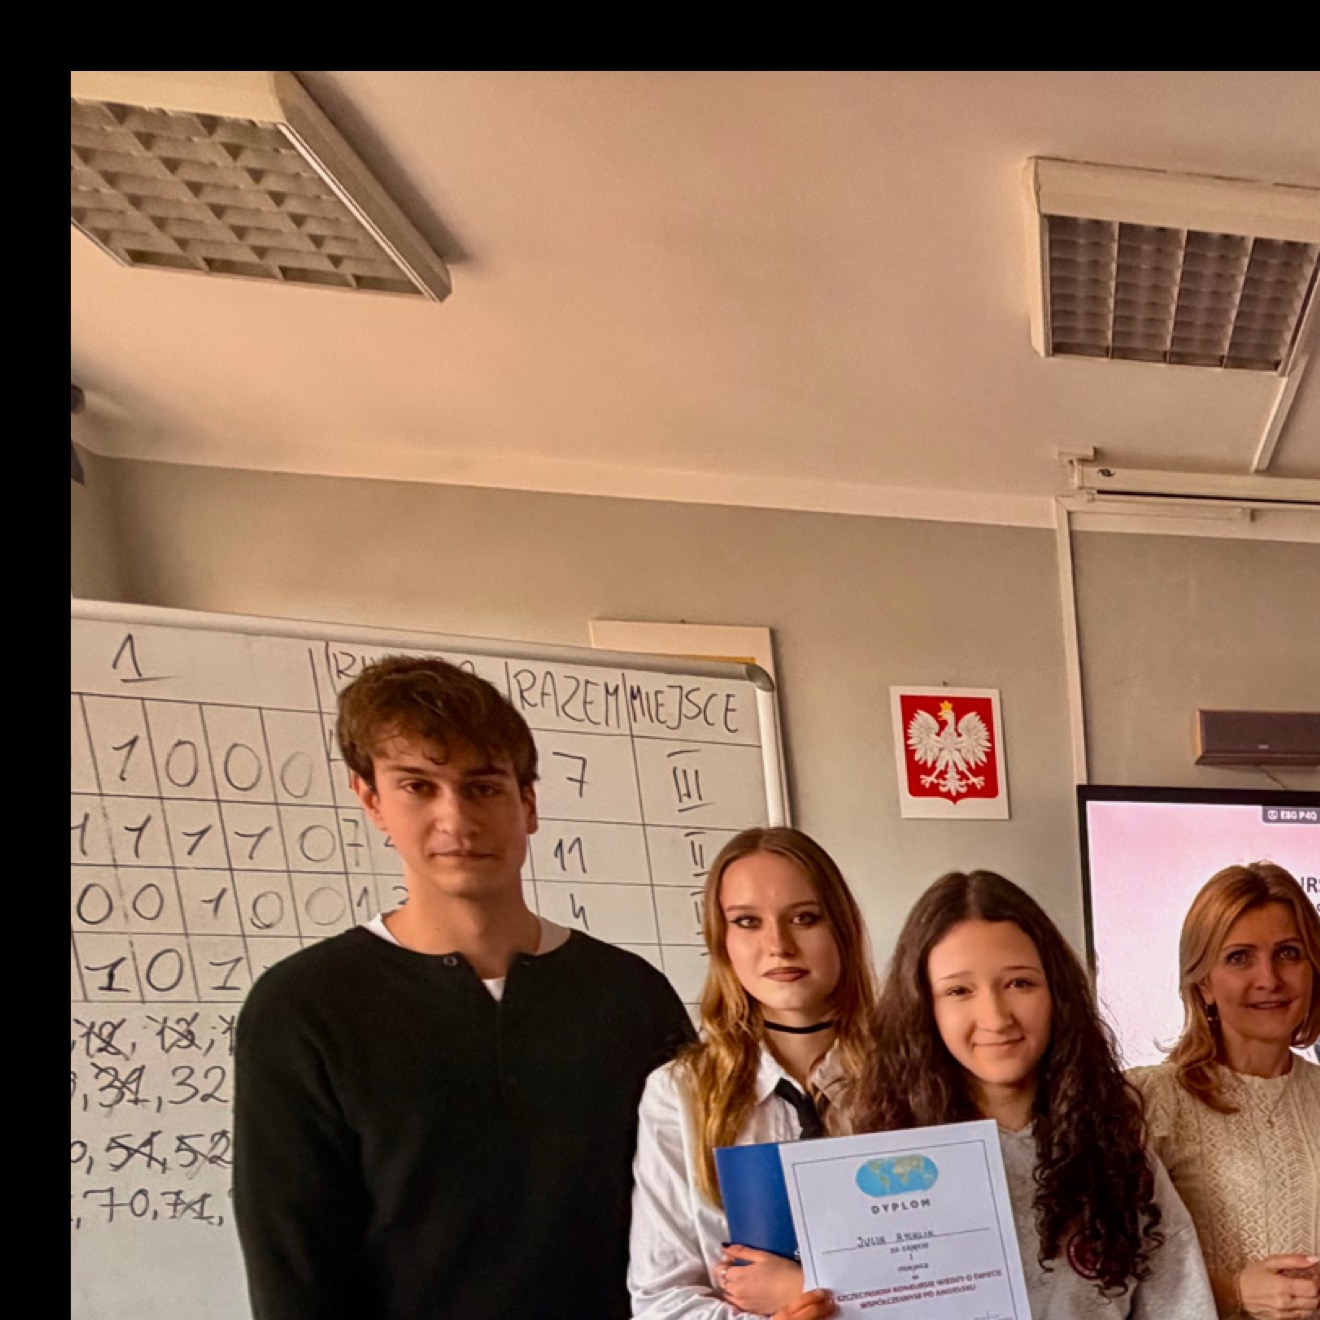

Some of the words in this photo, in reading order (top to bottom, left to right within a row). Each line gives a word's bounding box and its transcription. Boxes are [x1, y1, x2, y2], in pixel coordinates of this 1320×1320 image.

[513, 669, 621, 730] RAZEM
[630, 684, 739, 734] MIEJSCE
[112, 734, 139, 782] 1
[552, 751, 588, 798] 7
[123, 813, 152, 859] 1
[182, 823, 213, 856] 1
[342, 817, 364, 867] 7
[554, 836, 588, 875] 11
[201, 887, 228, 918] 1
[84, 956, 131, 993] 1
[208, 956, 244, 991] 1
[168, 1065, 229, 1105] 32
[870, 1198, 932, 1215] DYPLOM
